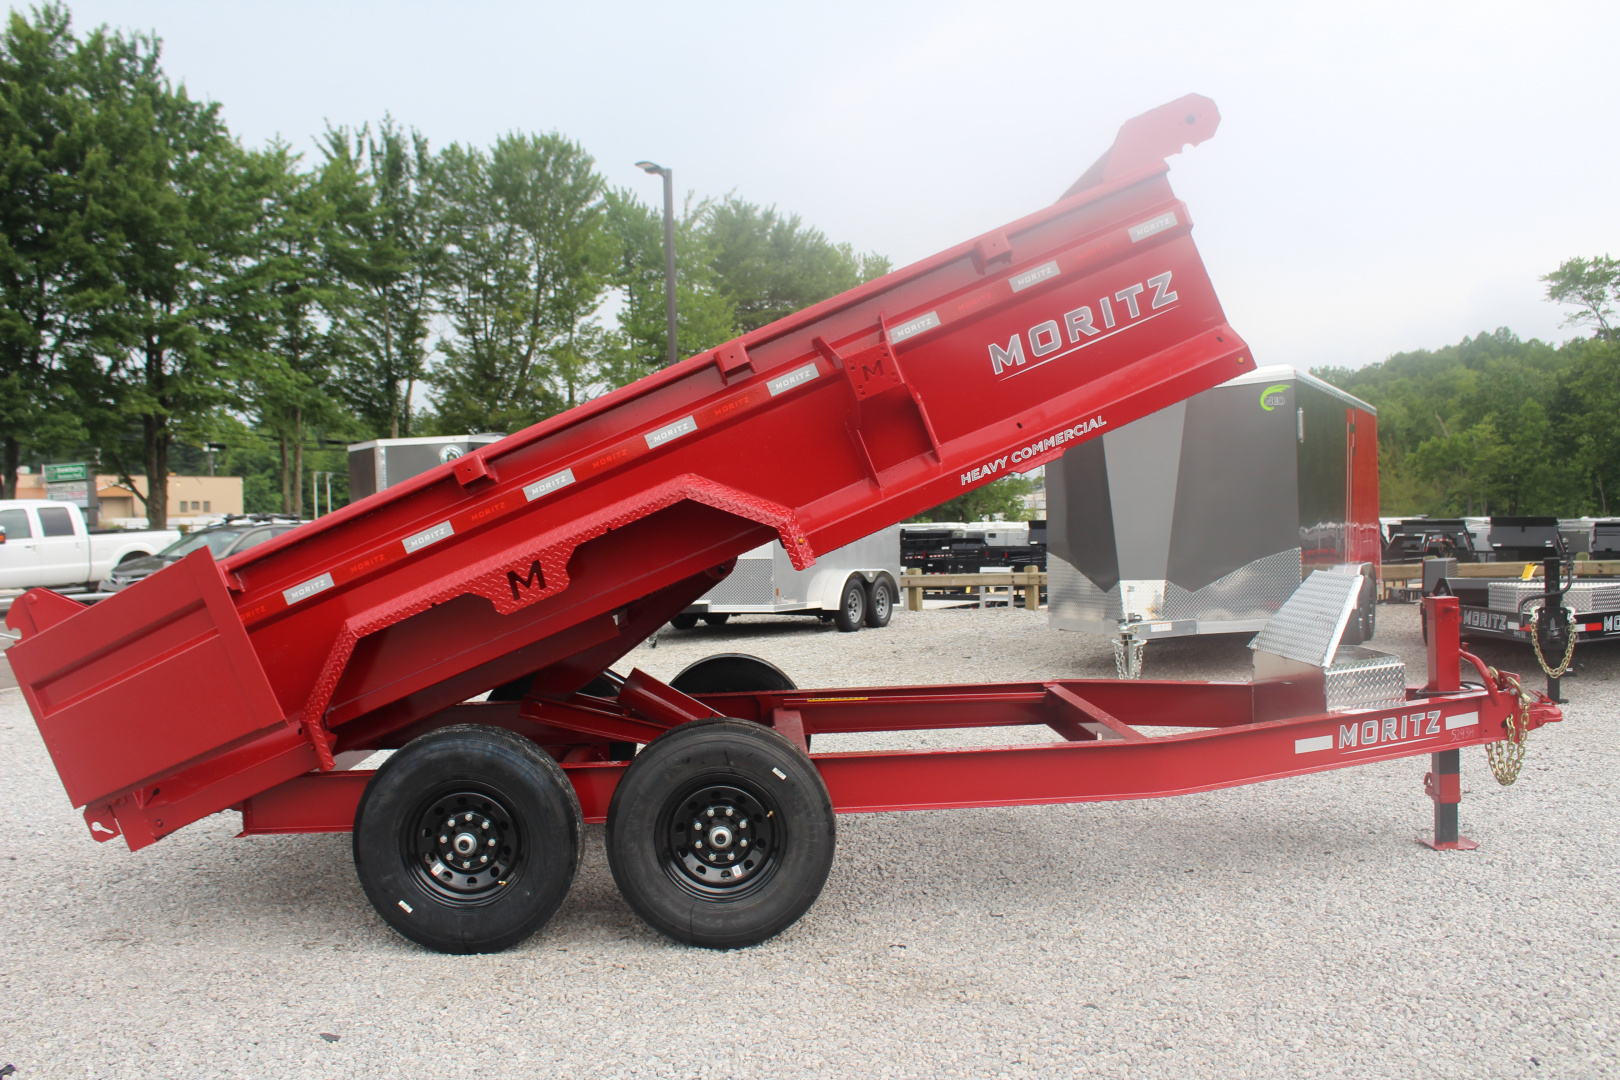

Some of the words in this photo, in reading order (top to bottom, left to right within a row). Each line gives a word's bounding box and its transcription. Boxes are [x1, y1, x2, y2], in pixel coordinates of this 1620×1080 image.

[1136, 217, 1171, 236] MORITZ
[1017, 267, 1052, 287] MORITZ
[897, 318, 933, 338] MORITZ
[987, 270, 1179, 376] MORITZ
[776, 369, 811, 390] MORITZ
[861, 359, 885, 382] M
[714, 396, 749, 416] MORITZ
[653, 422, 689, 443] MORITZ
[592, 448, 628, 469] MORITZ
[960, 455, 1008, 486] HEAVY
[1011, 415, 1107, 464] COMMERCIAL
[531, 475, 567, 495] MORITZ
[471, 501, 506, 521] MORITZ
[410, 527, 446, 547] MORITZ
[351, 553, 385, 573] MORITZ
[291, 579, 326, 599] MORITZ
[507, 559, 547, 601] M
[239, 605, 266, 621] ORITZ
[1463, 609, 1507, 631] MORITZ
[1338, 710, 1441, 749] MORITZ
